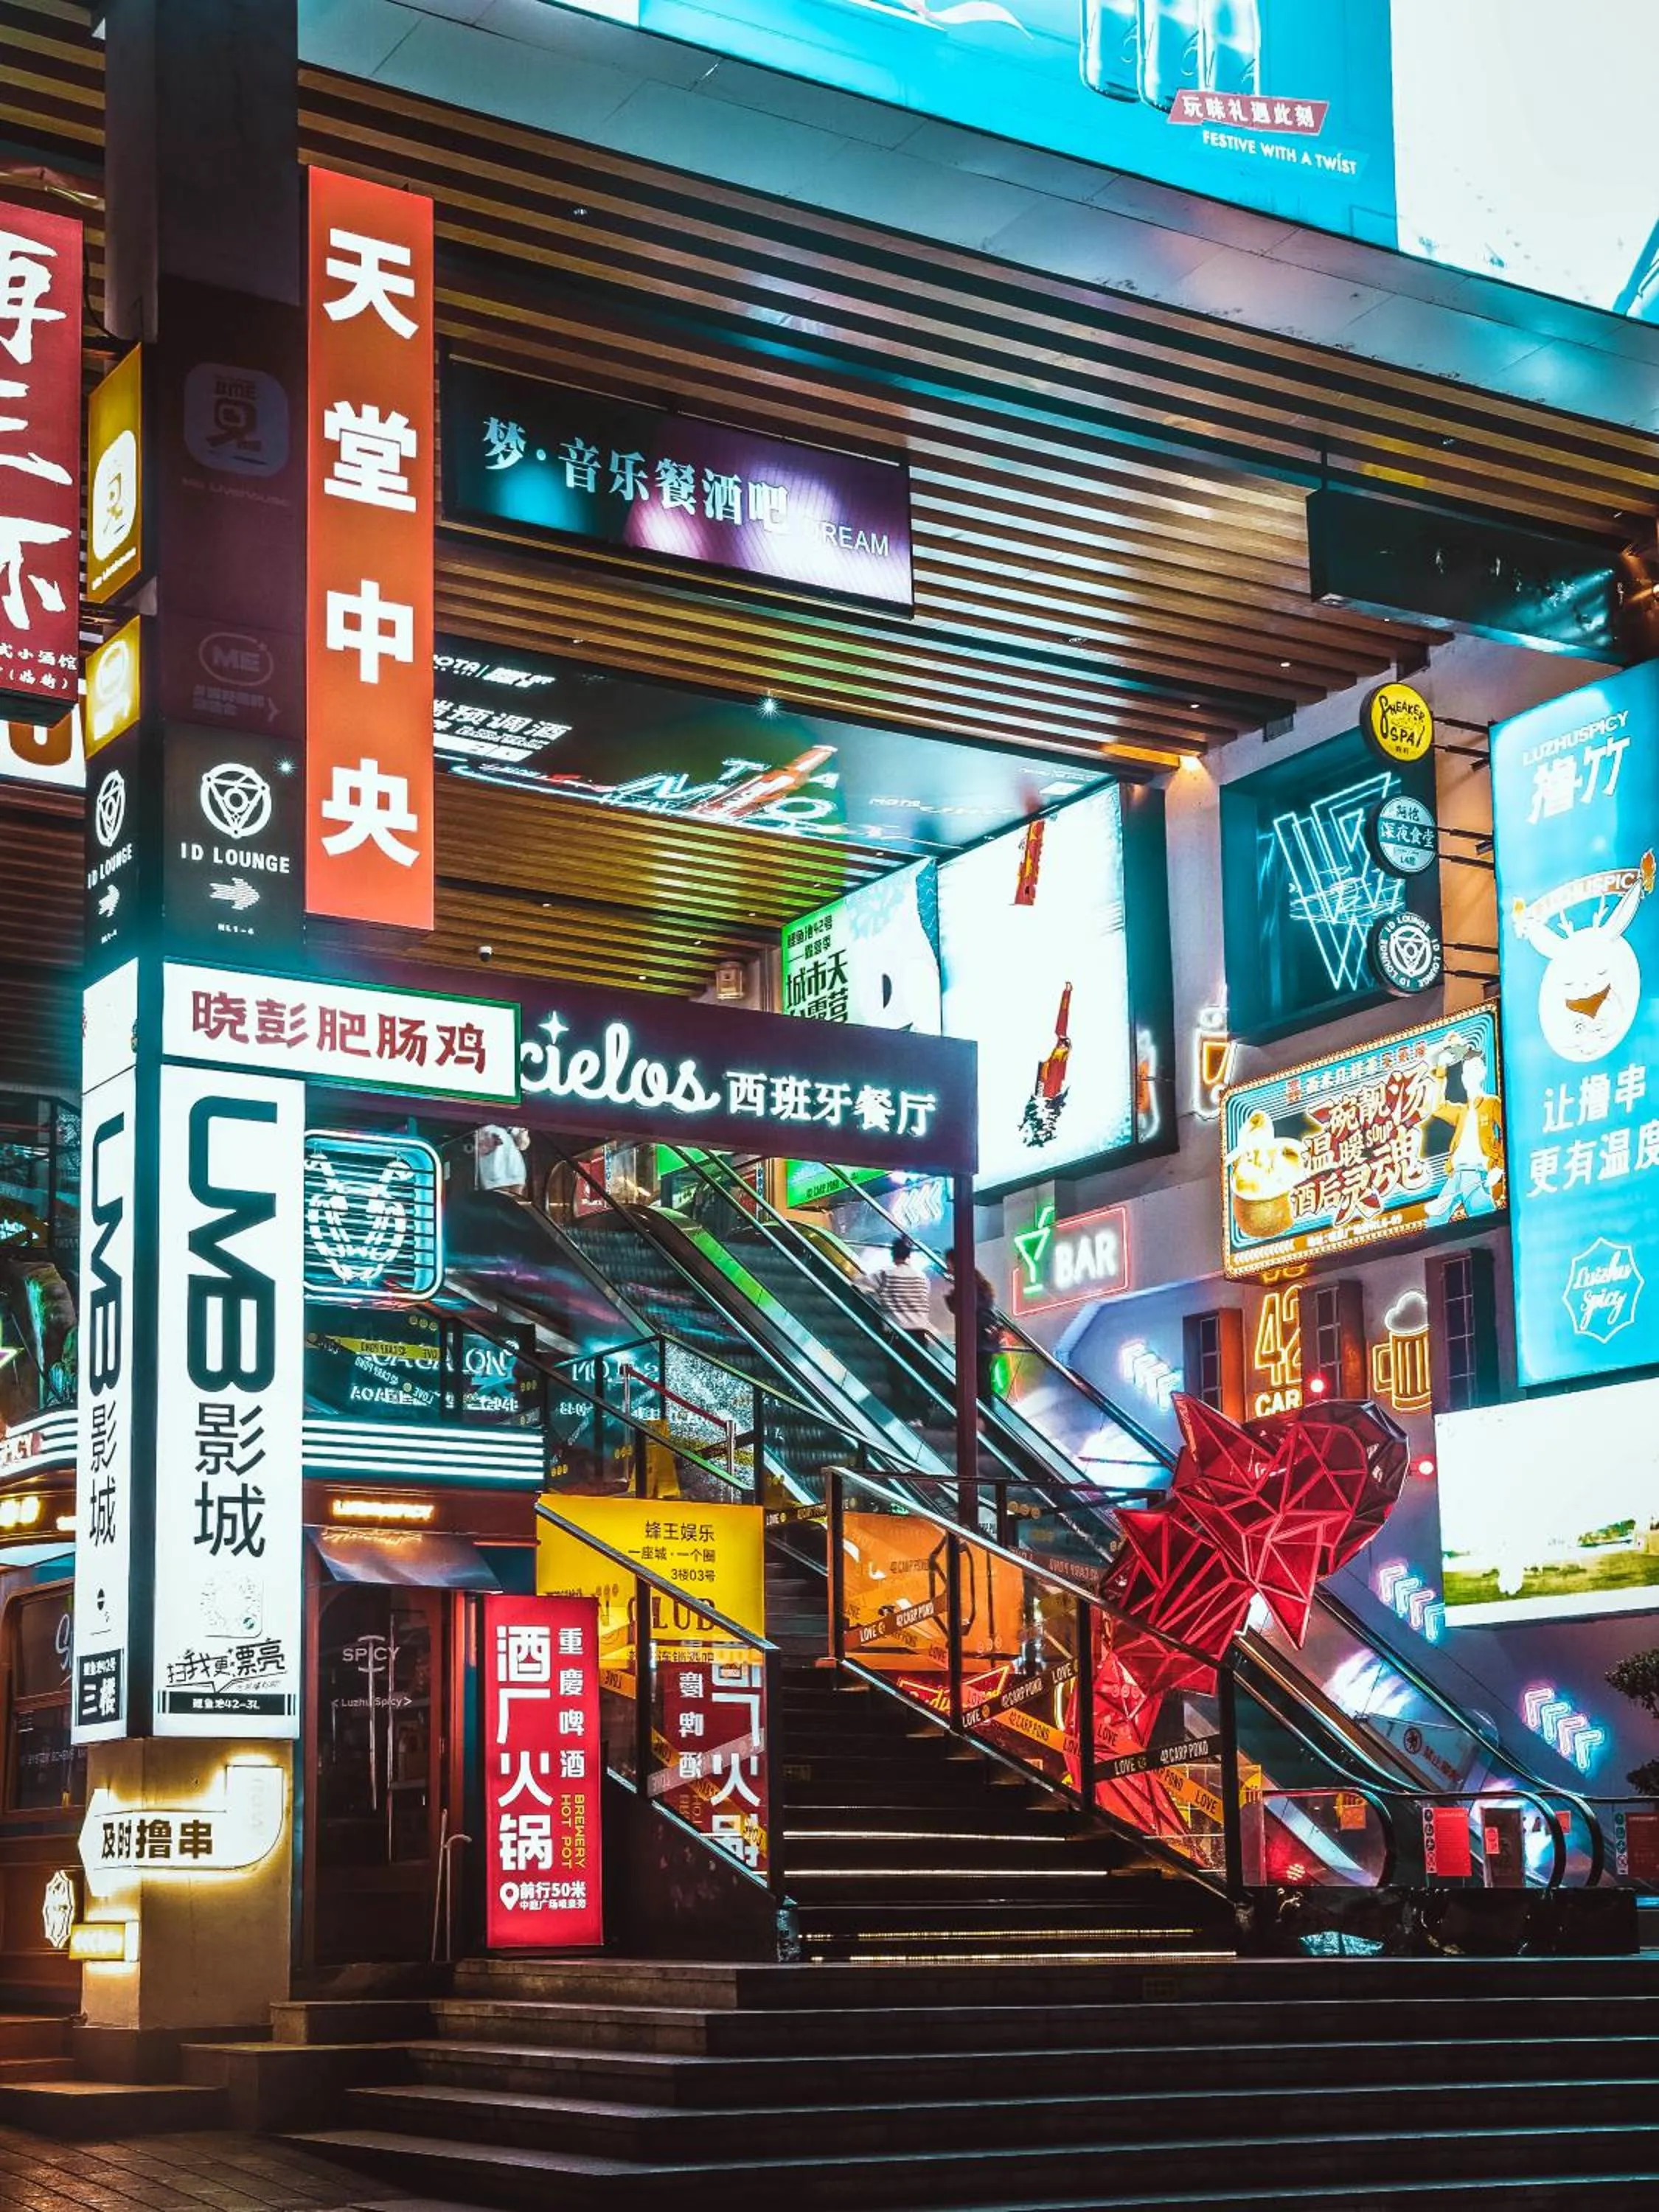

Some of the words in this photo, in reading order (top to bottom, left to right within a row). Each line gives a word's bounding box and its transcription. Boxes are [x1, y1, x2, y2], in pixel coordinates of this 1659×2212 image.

[1203, 130, 1256, 154] FESTIVE
[1259, 142, 1297, 163] WITH
[1301, 151, 1312, 166] A
[321, 228, 420, 867] 天堂中央
[809, 519, 889, 557] REAM
[1523, 710, 1629, 767] LUZHUSPICY
[181, 842, 204, 860] ID
[213, 847, 291, 874] LOUNGE
[1380, 821, 1435, 849] 深夜食堂
[88, 869, 99, 889] ID
[100, 843, 133, 880] LOUNGE
[790, 987, 849, 1023] 露营
[191, 990, 487, 1074] 晓彭肥肠鸡
[726, 1069, 936, 1138] 西班牙餐厅
[1542, 1062, 1646, 1134] 让撸串
[1366, 1120, 1394, 1148] SOUP
[1526, 1119, 1659, 1198] 更有温度
[1054, 1231, 1117, 1289] BAR
[89, 1401, 117, 1547] 影城
[193, 1402, 266, 1558] 影城
[644, 1520, 715, 1543] 蜂王娱乐
[342, 1646, 400, 1661] SPICY
[558, 1627, 585, 1778] 重慶啤酒
[962, 1711, 982, 1728] LOVE
[1052, 1663, 1073, 1684] LOVE
[495, 1624, 554, 1871] 酒厂火锅
[1114, 1757, 1136, 1775] LOVE
[561, 1794, 571, 1827] HOT
[574, 1794, 587, 1869] BREWERY
[101, 1818, 214, 1860] 及时撸串
[561, 1836, 572, 1868] POT
[520, 1881, 587, 1899] 前行50米
